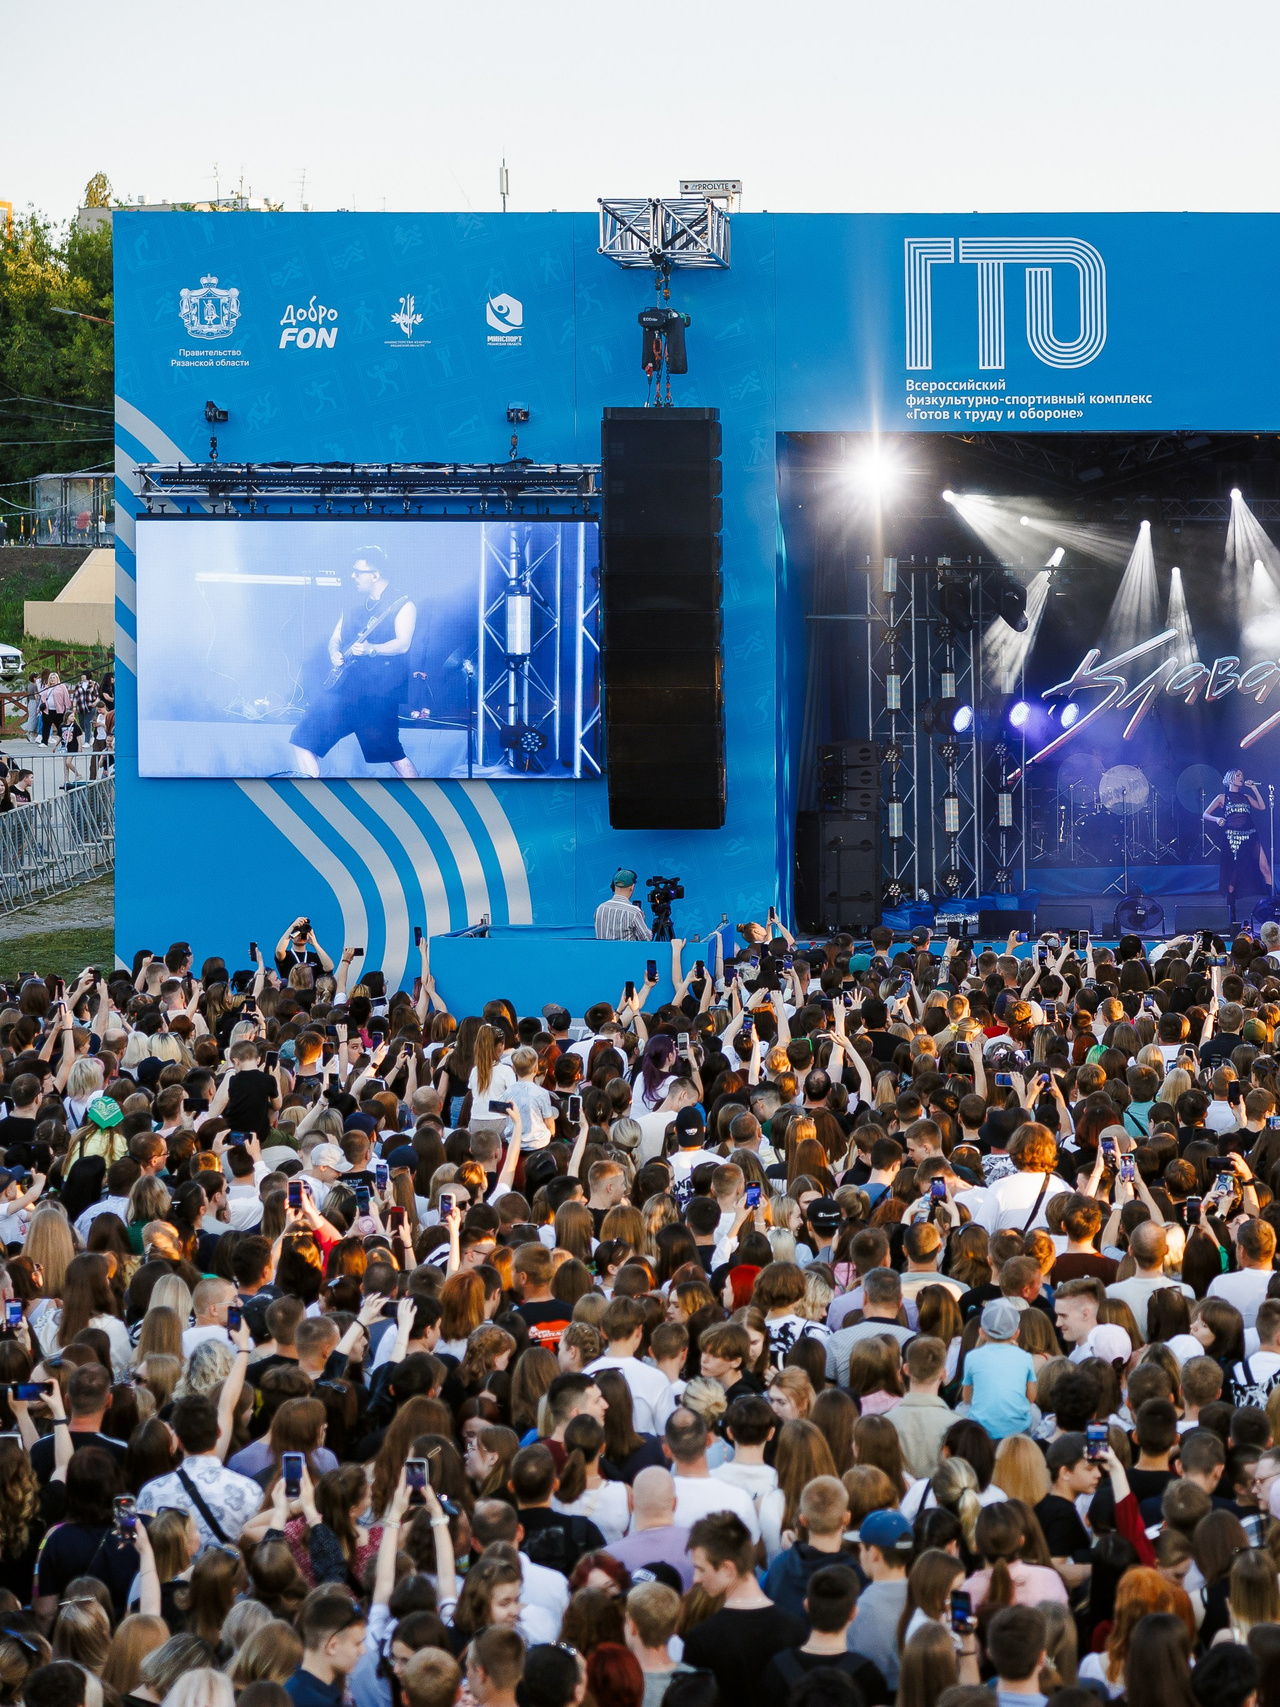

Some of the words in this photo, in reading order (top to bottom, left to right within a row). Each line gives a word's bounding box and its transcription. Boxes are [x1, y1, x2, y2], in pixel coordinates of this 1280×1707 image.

[280, 295, 339, 326] Добро
[904, 236, 1108, 370] ГТО
[279, 327, 339, 349] FON
[487, 335, 523, 343] МИНСПОРТ
[178, 348, 242, 357] Правительство
[171, 359, 214, 367] Рязанской
[215, 359, 250, 367] области
[905, 379, 1007, 394] Всероссийский
[905, 393, 1086, 408] физкультурно-спортивный
[1089, 394, 1153, 404] комплекс
[906, 409, 950, 420] «Готов
[954, 410, 962, 420] к
[964, 410, 1004, 423] труду
[1007, 410, 1016, 420] и
[1019, 408, 1084, 421] обороне»
